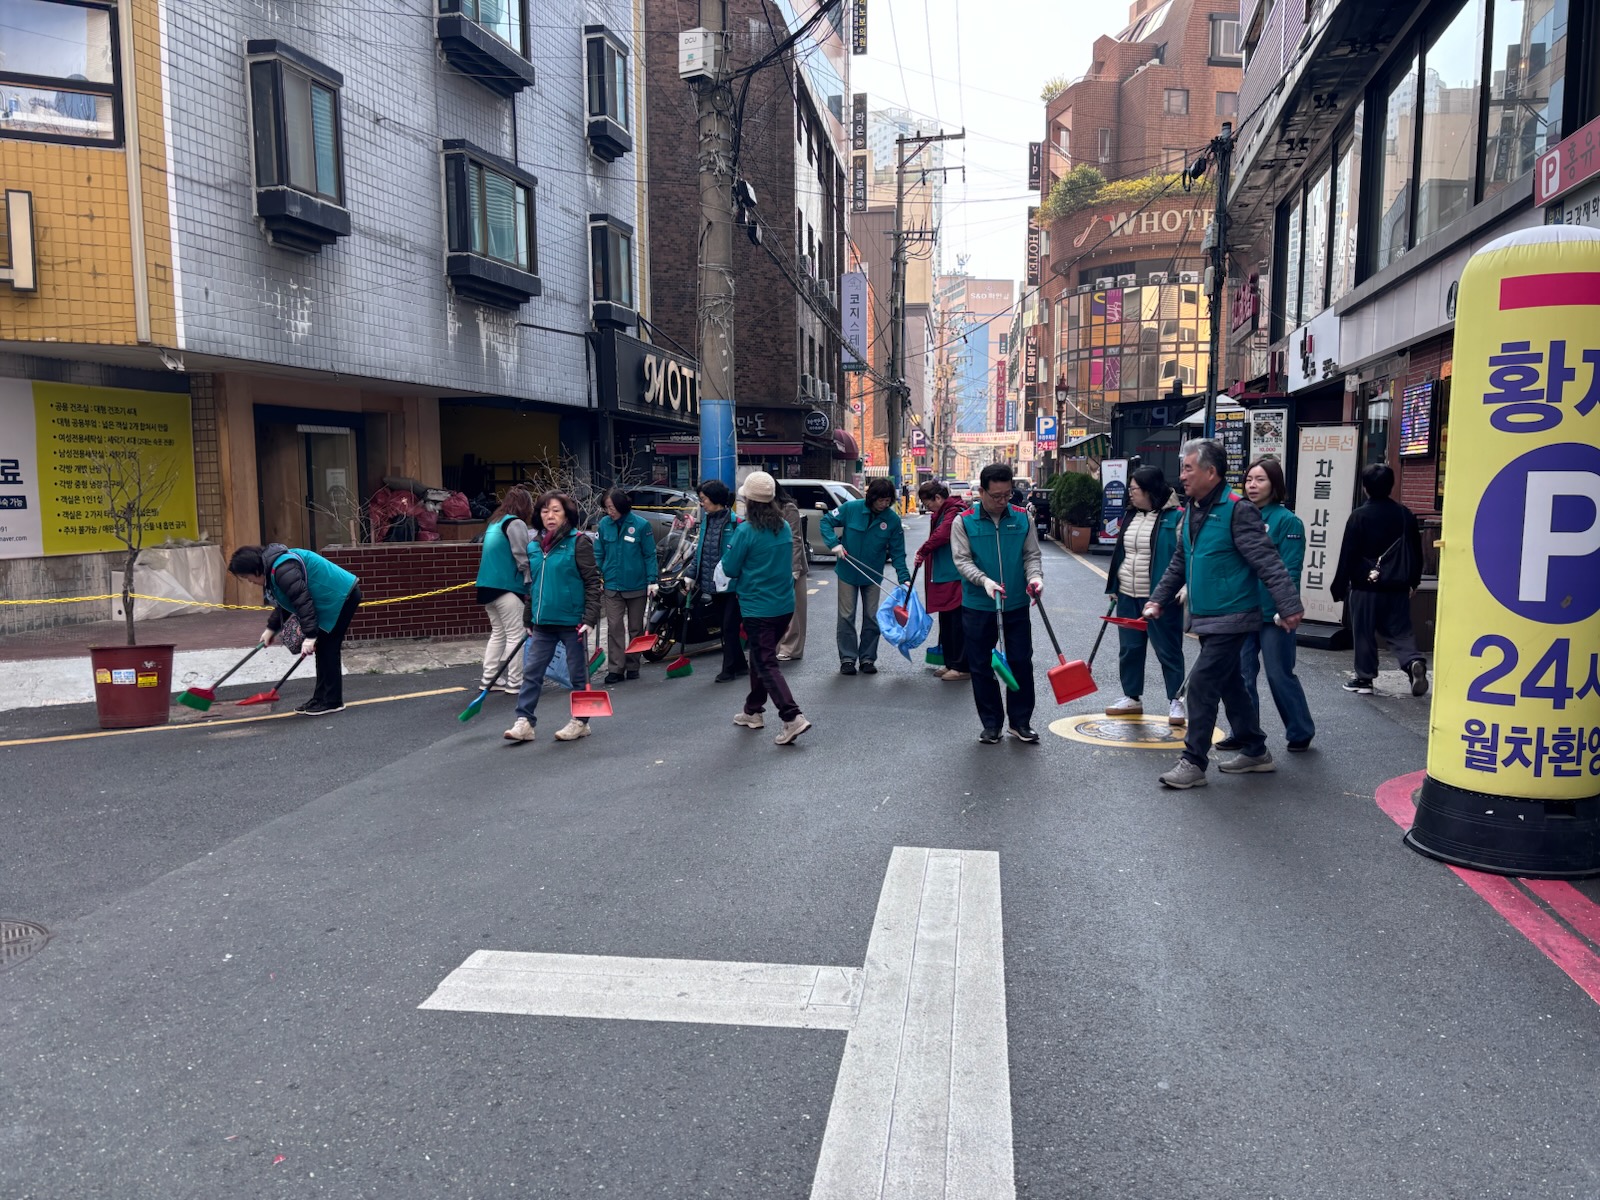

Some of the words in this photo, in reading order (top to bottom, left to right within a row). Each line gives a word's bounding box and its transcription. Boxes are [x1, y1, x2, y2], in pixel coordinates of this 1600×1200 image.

[684, 36, 697, 44] DCU
[1564, 130, 1600, 180] 홍유
[1028, 234, 1038, 278] HOTEL
[70, 403, 89, 413] 건조실
[1040, 418, 1054, 434] P
[912, 430, 924, 446] P
[1302, 435, 1354, 451] 점심특선
[1038, 441, 1049, 450] 24
[59, 464, 73, 475] 각방
[1314, 459, 1333, 499] 차돌
[59, 480, 73, 490] 각방
[10, 498, 23, 507] 가능
[60, 495, 80, 504] 객실은
[62, 511, 82, 520] 객실은
[63, 526, 77, 535] 주차
[1519, 471, 1600, 602] P
[1306, 509, 1329, 590] 샤브샤브
